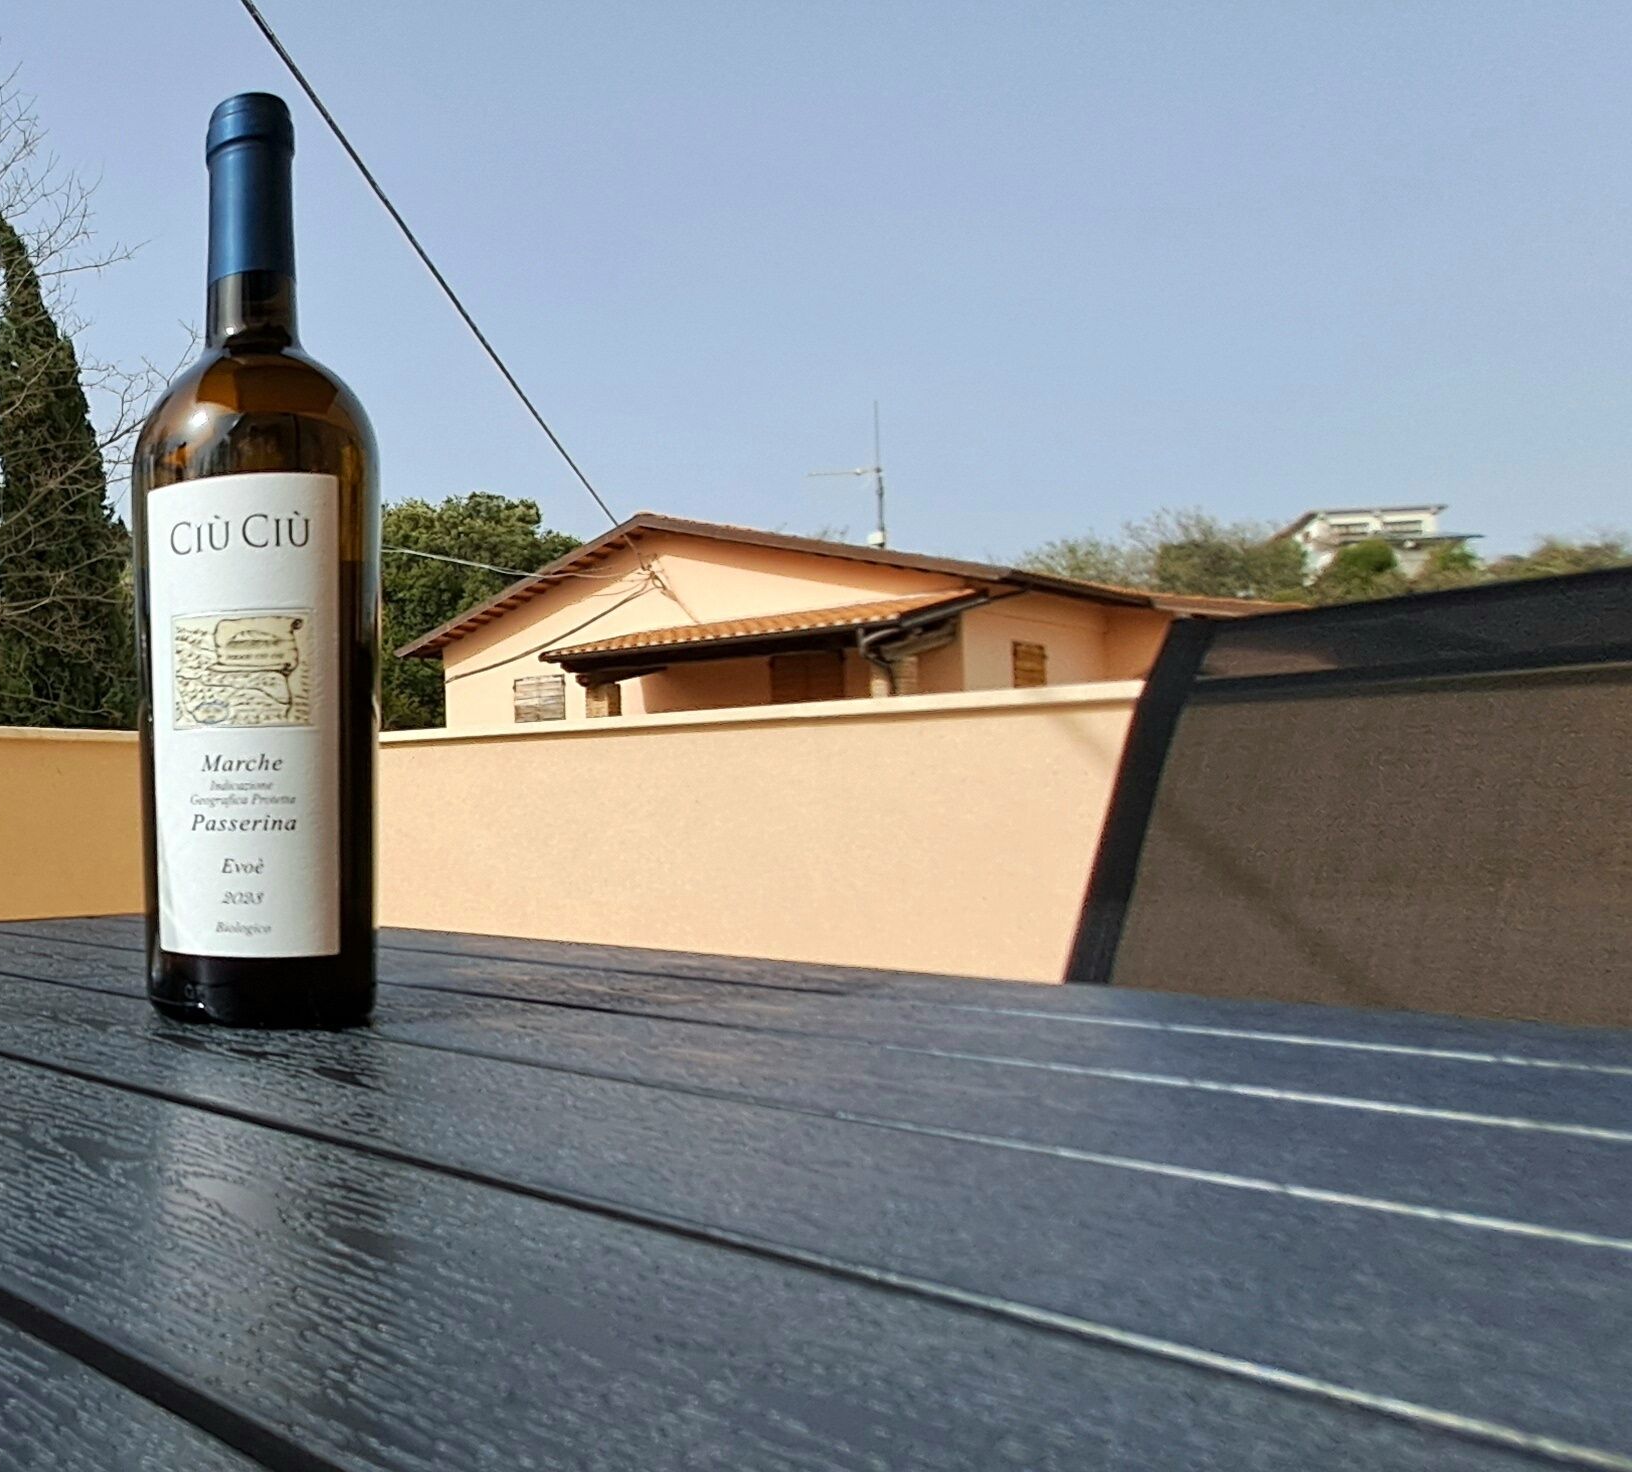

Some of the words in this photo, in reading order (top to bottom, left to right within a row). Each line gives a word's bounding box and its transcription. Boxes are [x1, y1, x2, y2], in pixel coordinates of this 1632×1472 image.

[201, 753, 283, 772] Marche
[209, 780, 273, 791] Indicazione
[190, 794, 248, 808] Geografica
[191, 814, 297, 831] Passerina
[221, 858, 264, 874] Evoè
[216, 921, 272, 936] Biologico
